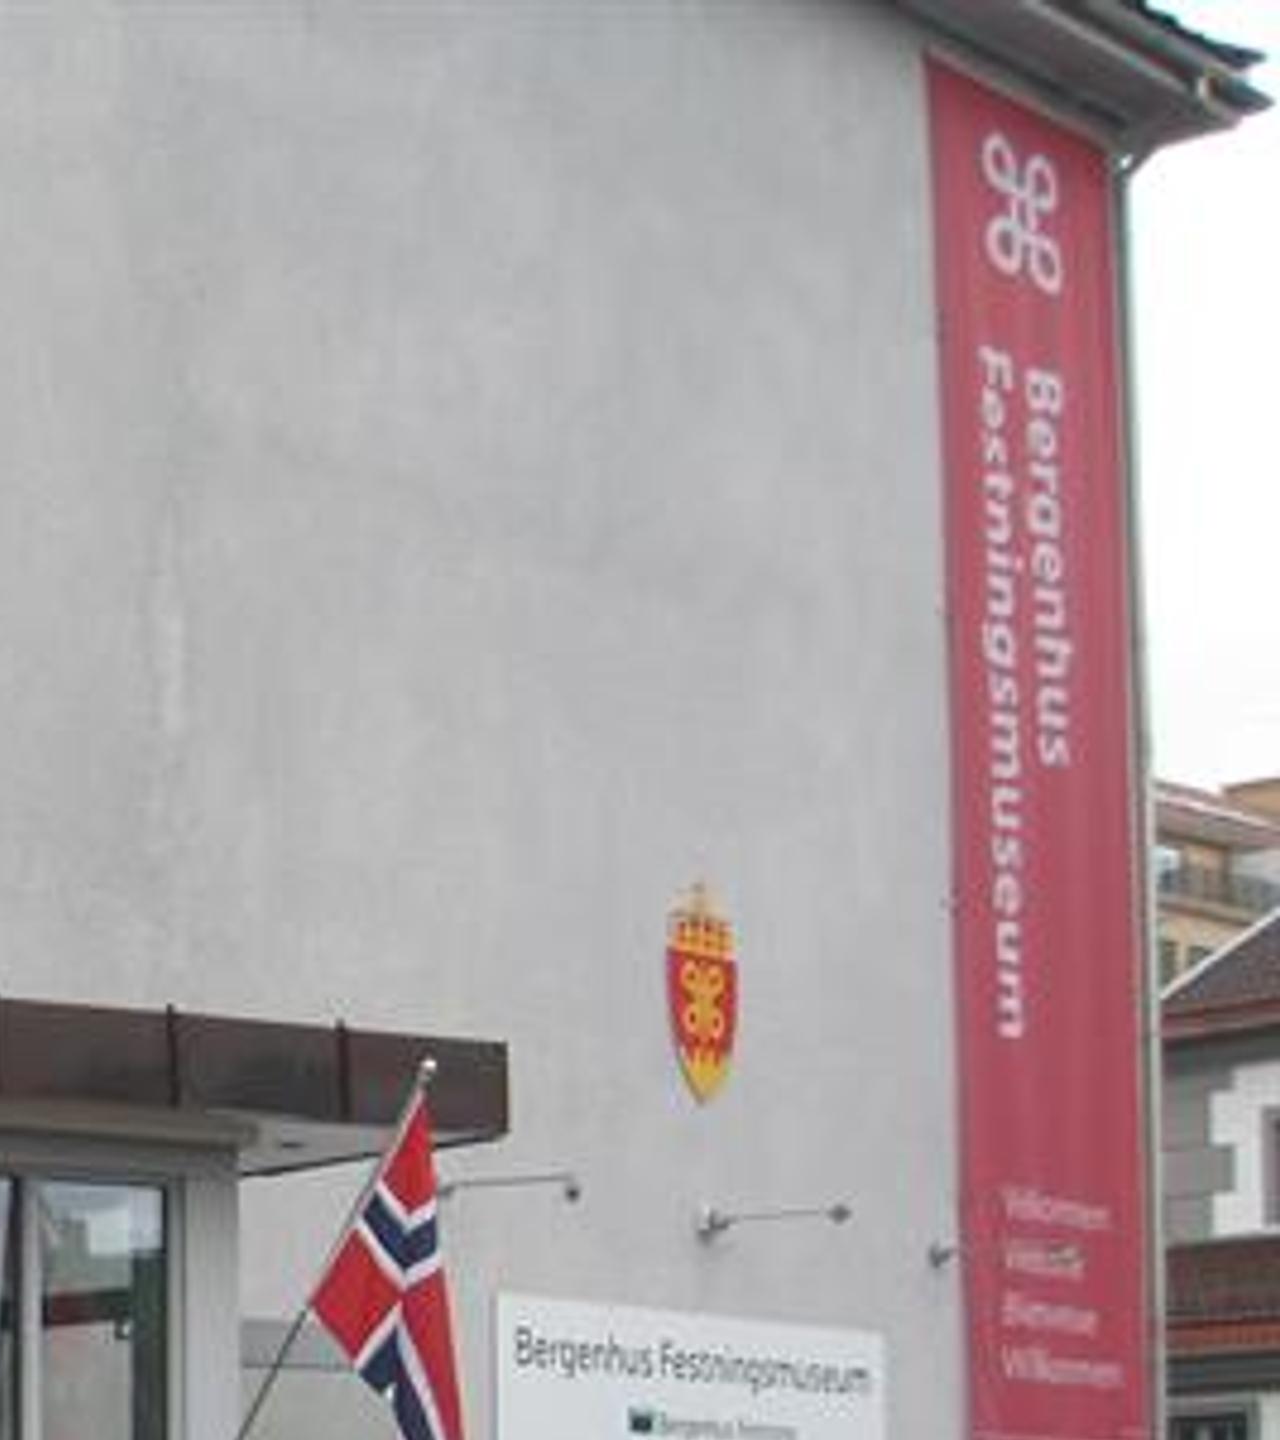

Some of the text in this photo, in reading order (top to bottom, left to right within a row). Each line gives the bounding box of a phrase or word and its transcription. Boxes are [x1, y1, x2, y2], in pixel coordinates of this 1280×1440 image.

[977, 344, 1025, 1042] Festningsmuseum
[1022, 367, 1072, 770] Bergenhus
[513, 1325, 872, 1396] Bergenhus Festningsmuseum
